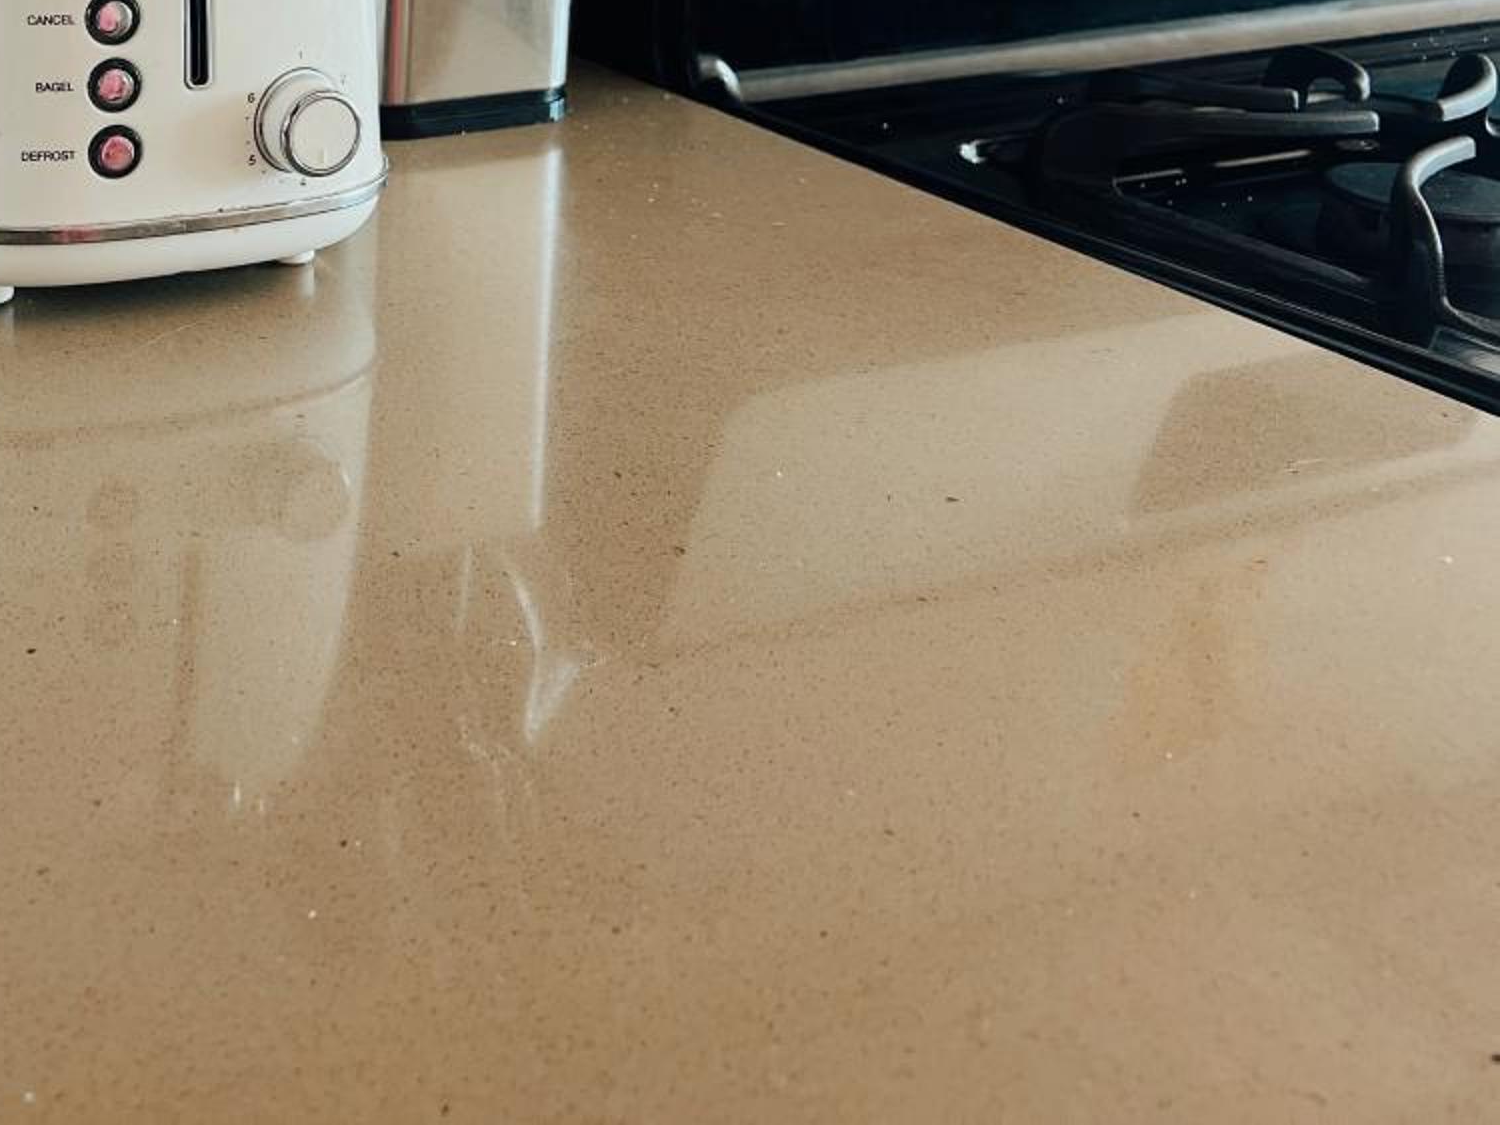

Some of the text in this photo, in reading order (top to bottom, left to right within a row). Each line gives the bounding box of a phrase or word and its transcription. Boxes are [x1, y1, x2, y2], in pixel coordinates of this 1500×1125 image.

[27, 14, 75, 26] CANCEL
[35, 82, 74, 93] BAGEL
[21, 150, 75, 162] DEFROST
